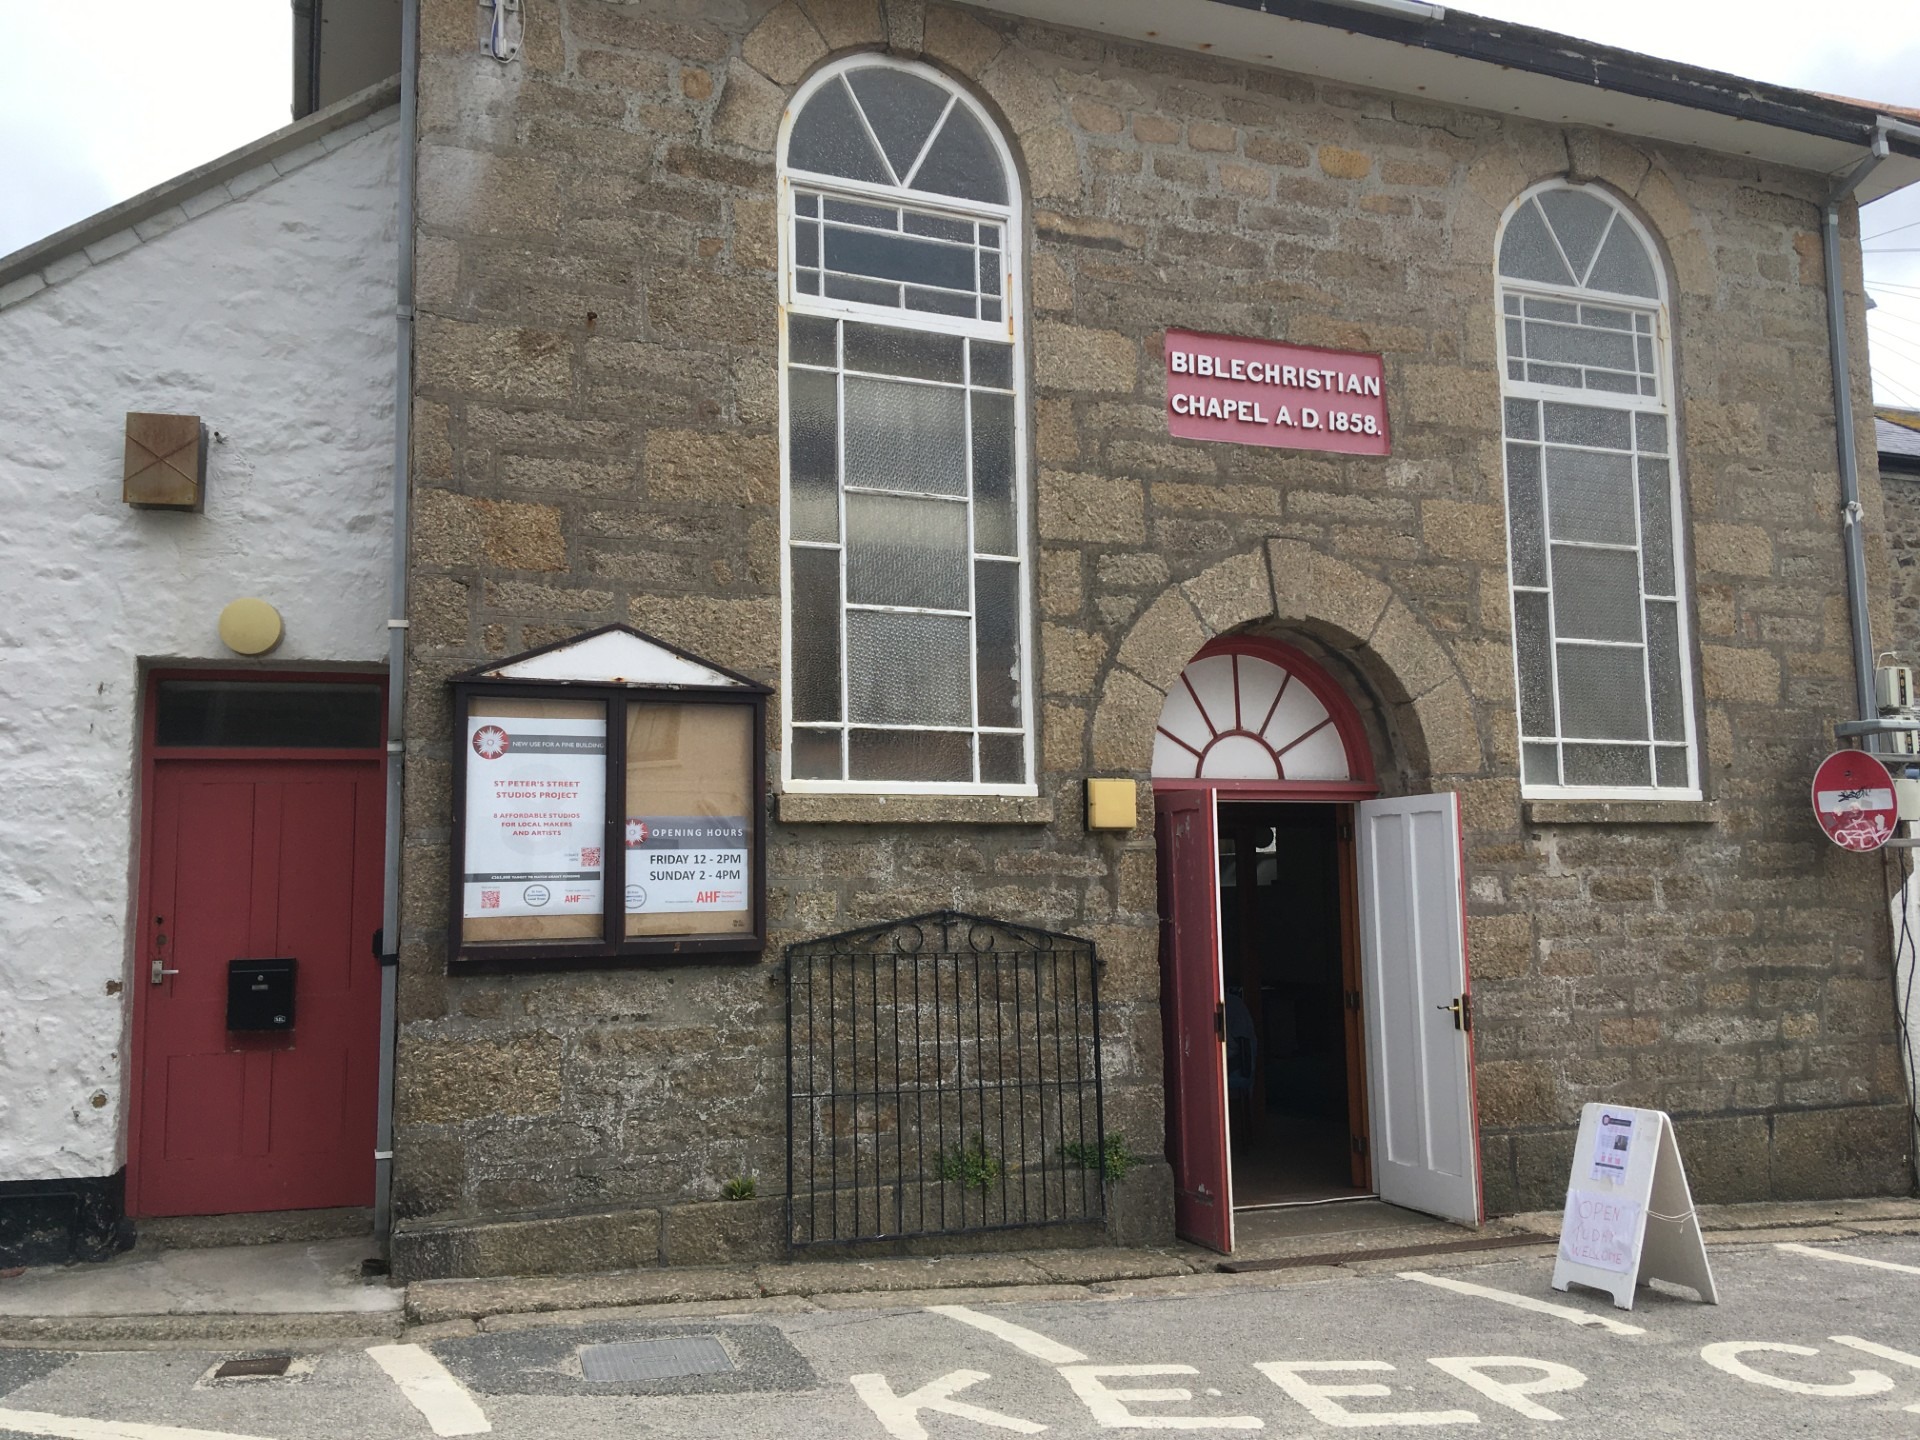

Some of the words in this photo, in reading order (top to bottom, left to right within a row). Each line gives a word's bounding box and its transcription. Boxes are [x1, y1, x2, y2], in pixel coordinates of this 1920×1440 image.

[1171, 393, 1269, 425] CHAPEL
[1328, 410, 1382, 436] 1858.
[496, 791, 537, 799] STUDIOS
[652, 828, 702, 837] OPENING
[706, 828, 744, 837] HOURS
[649, 854, 689, 865] FRIDAY
[693, 854, 707, 865] 12
[716, 853, 742, 864] 2PM
[649, 870, 696, 881] SUNDAY
[699, 870, 706, 880] 2
[715, 869, 741, 880] 4PM
[564, 894, 581, 903] AHF
[696, 890, 721, 903] AHF
[1579, 1200, 1620, 1222] OPEN
[850, 1355, 1588, 1440] KEEP
